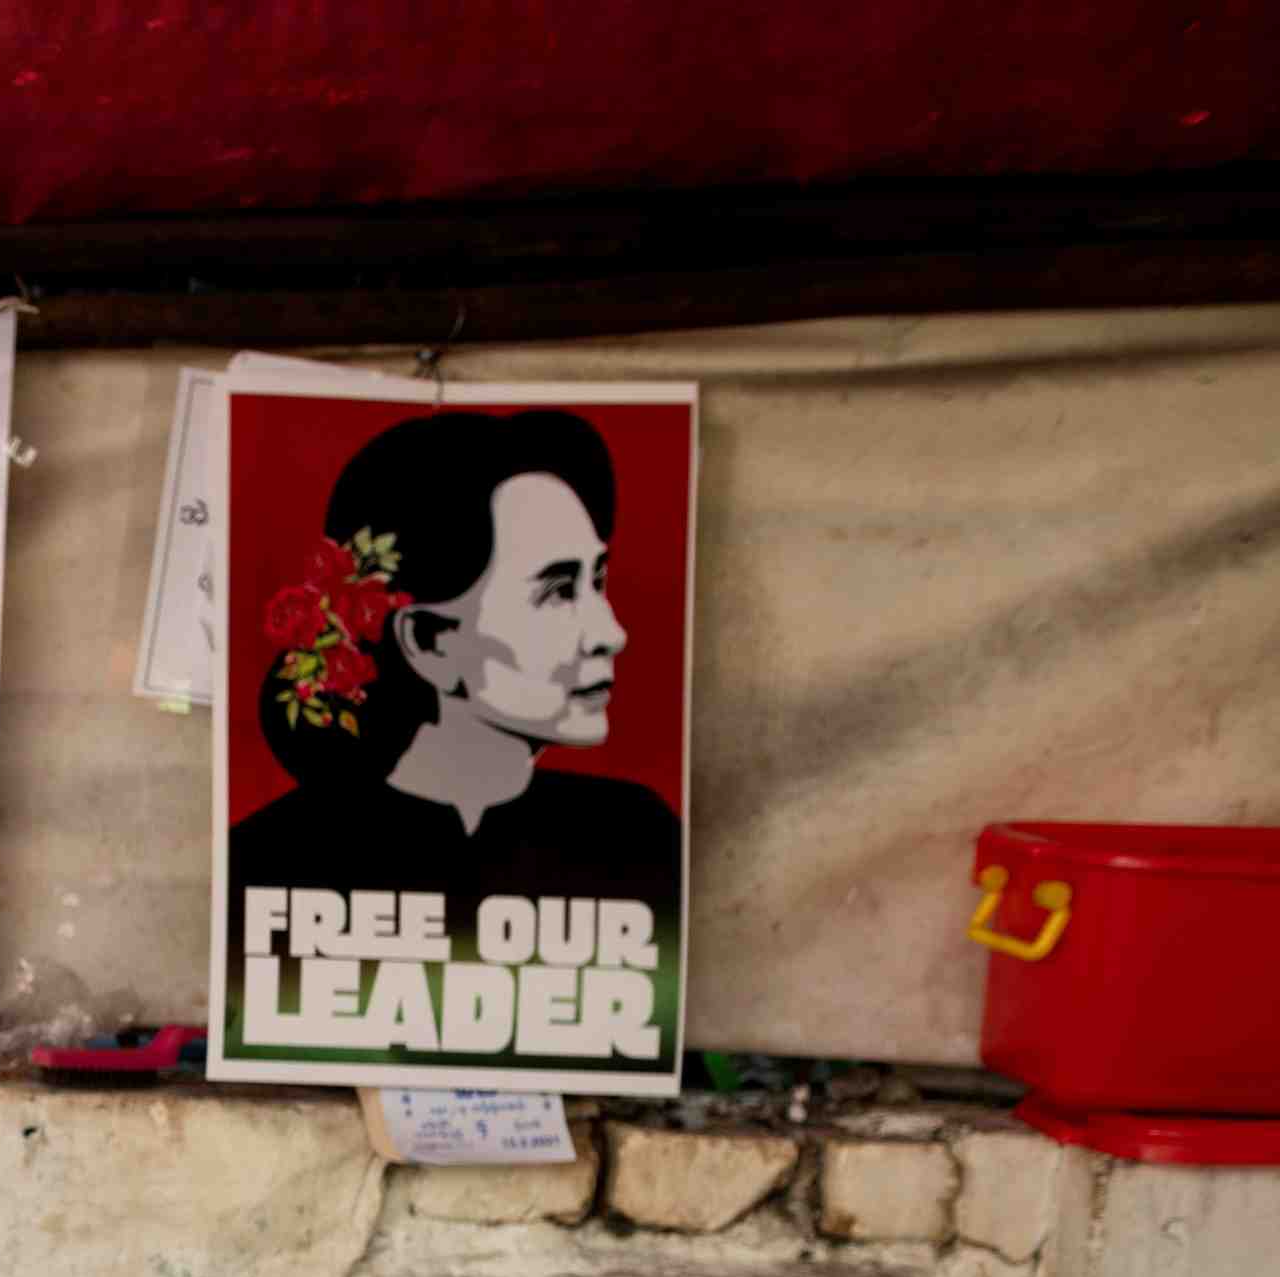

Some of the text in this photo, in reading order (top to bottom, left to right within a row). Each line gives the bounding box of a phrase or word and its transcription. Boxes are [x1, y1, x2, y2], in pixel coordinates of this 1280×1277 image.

[245, 886, 659, 971] FREE OUR
[242, 954, 661, 1060] LEADER
